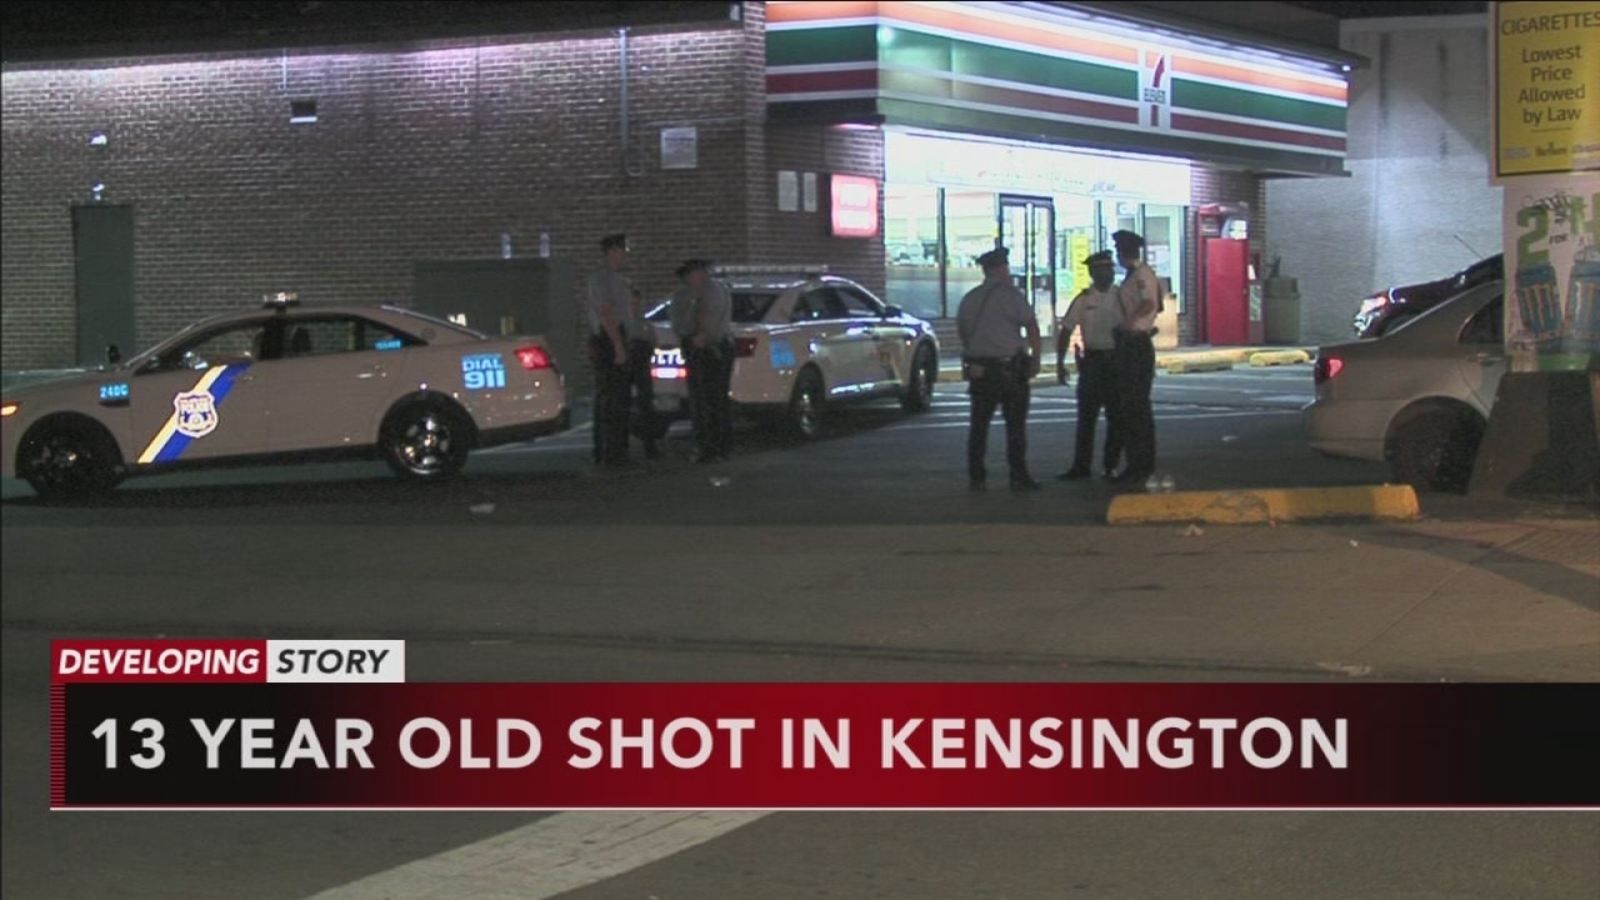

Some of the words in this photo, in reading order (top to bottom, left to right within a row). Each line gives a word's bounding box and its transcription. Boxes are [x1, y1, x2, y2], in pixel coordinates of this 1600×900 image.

[1522, 44, 1582, 63] Lowest
[1531, 65, 1573, 82] Price
[1518, 83, 1586, 104] Allowed
[1523, 107, 1543, 127] by
[1547, 106, 1582, 122] Law
[463, 358, 504, 372] DIAL
[464, 369, 506, 390] 911
